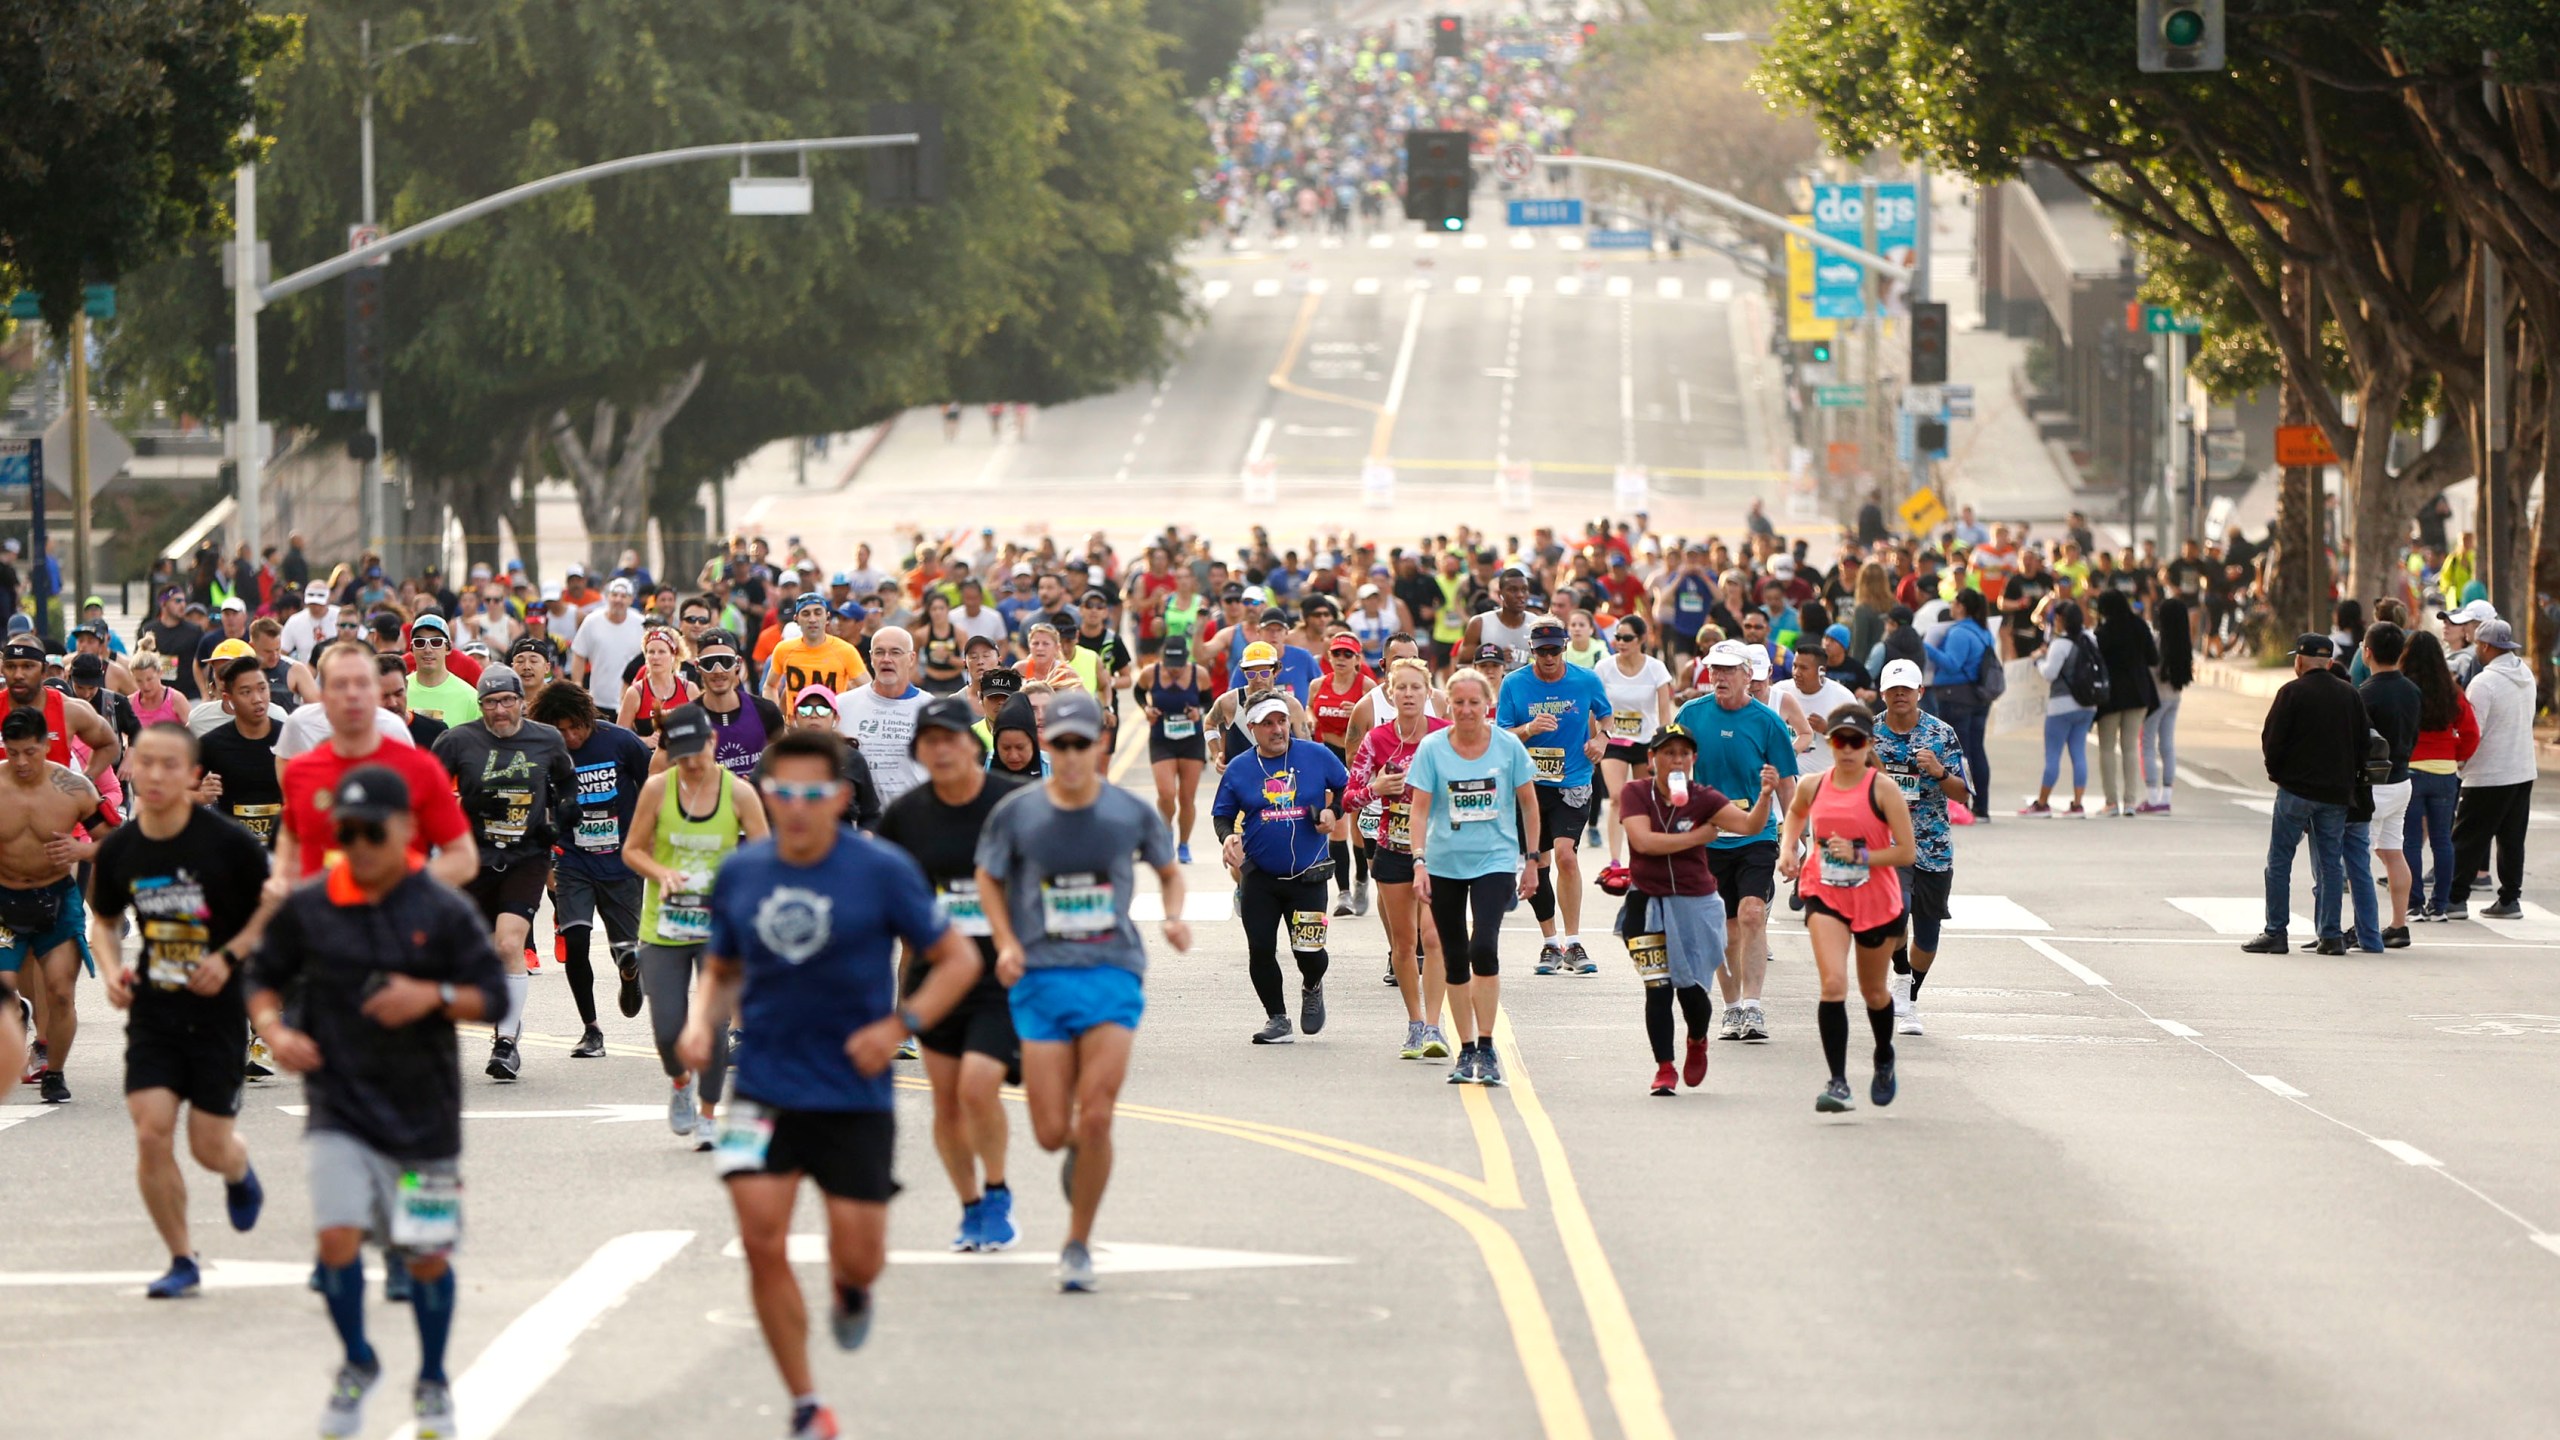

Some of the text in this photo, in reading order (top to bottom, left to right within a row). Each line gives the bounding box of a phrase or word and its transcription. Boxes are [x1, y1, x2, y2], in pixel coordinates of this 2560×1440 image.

[991, 678, 1011, 688] SRLA
[1665, 723, 1685, 736] LA
[481, 749, 538, 782] LA
[1453, 792, 1493, 808] E8878
[579, 820, 614, 834] 24243
[1294, 924, 1326, 940] C4977
